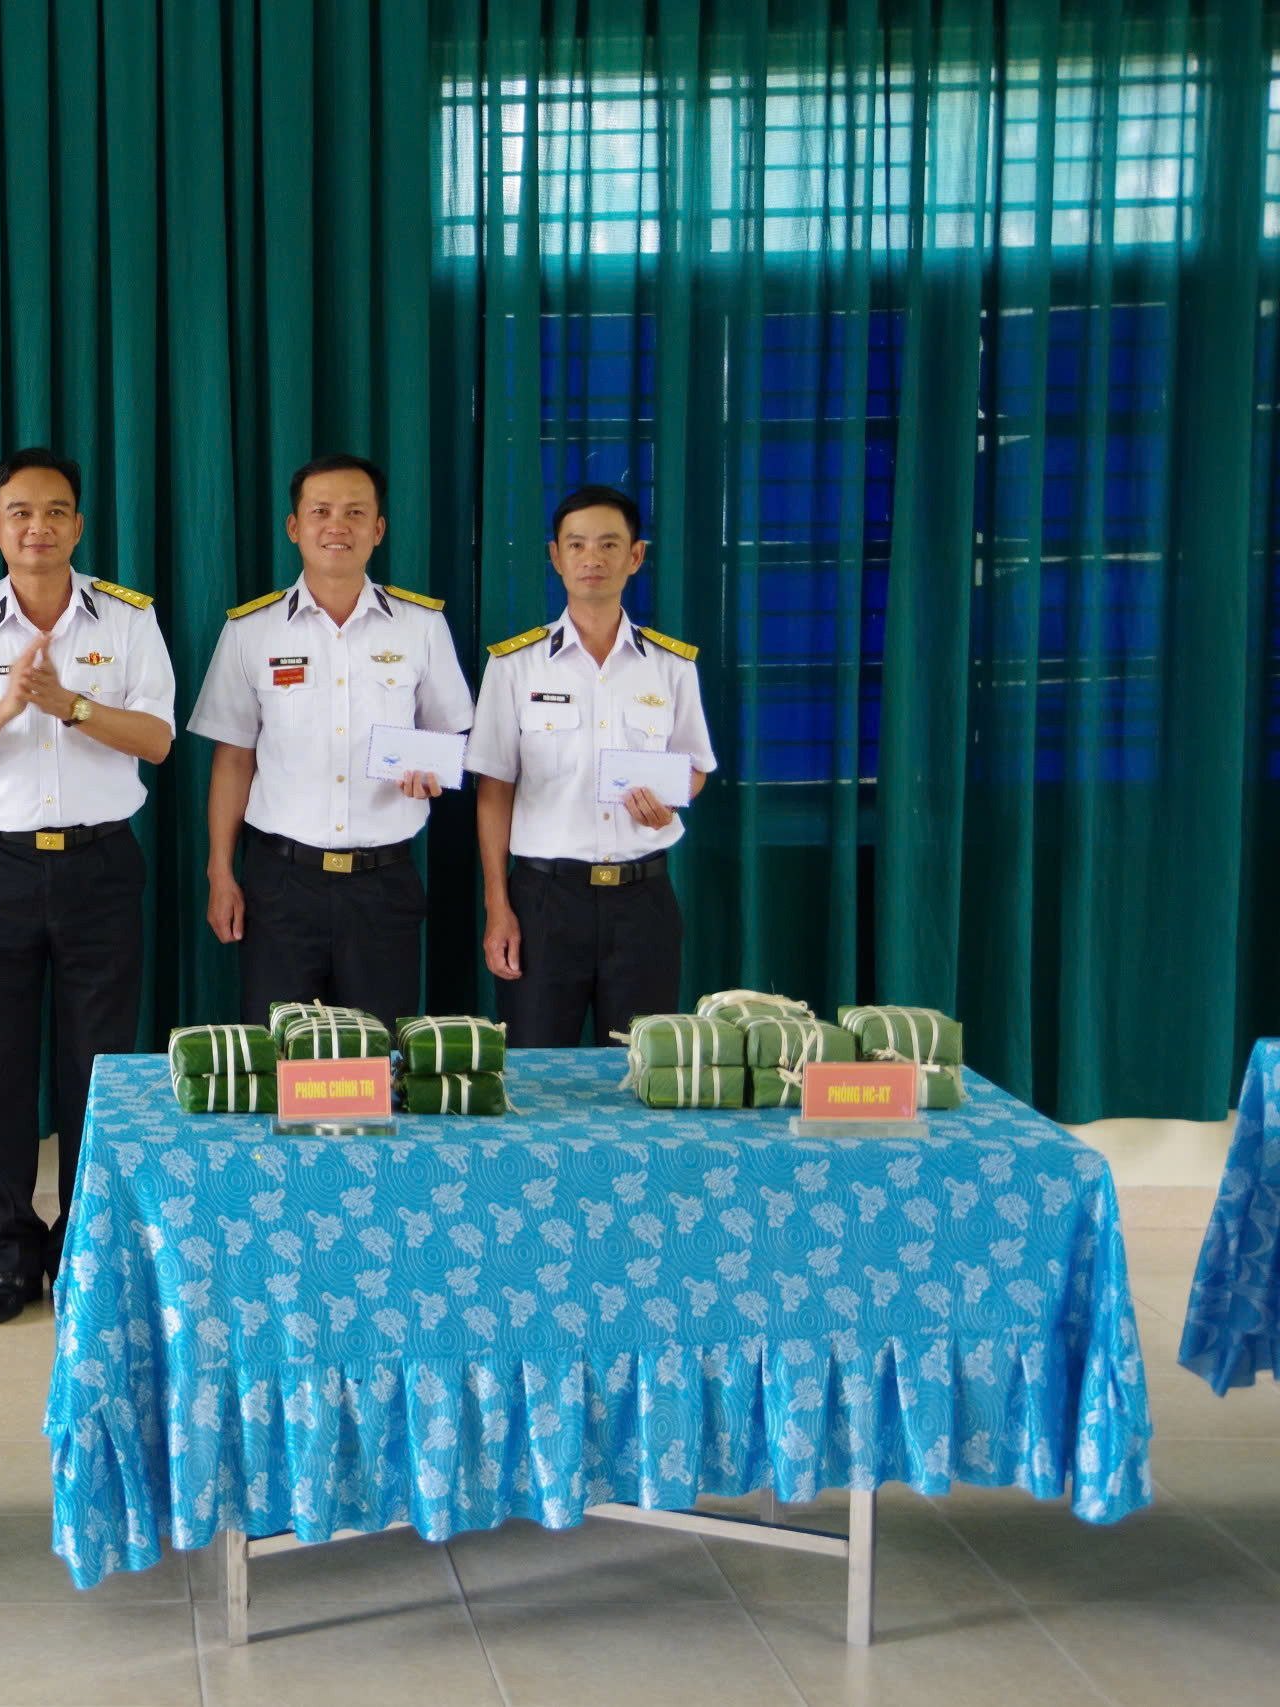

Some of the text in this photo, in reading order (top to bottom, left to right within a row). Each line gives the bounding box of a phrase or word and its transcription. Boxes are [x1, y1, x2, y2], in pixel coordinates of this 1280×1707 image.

[294, 1077, 375, 1101] PHÒNG CHÍNH TRỊ
[828, 1081, 860, 1104] PHÒNG
